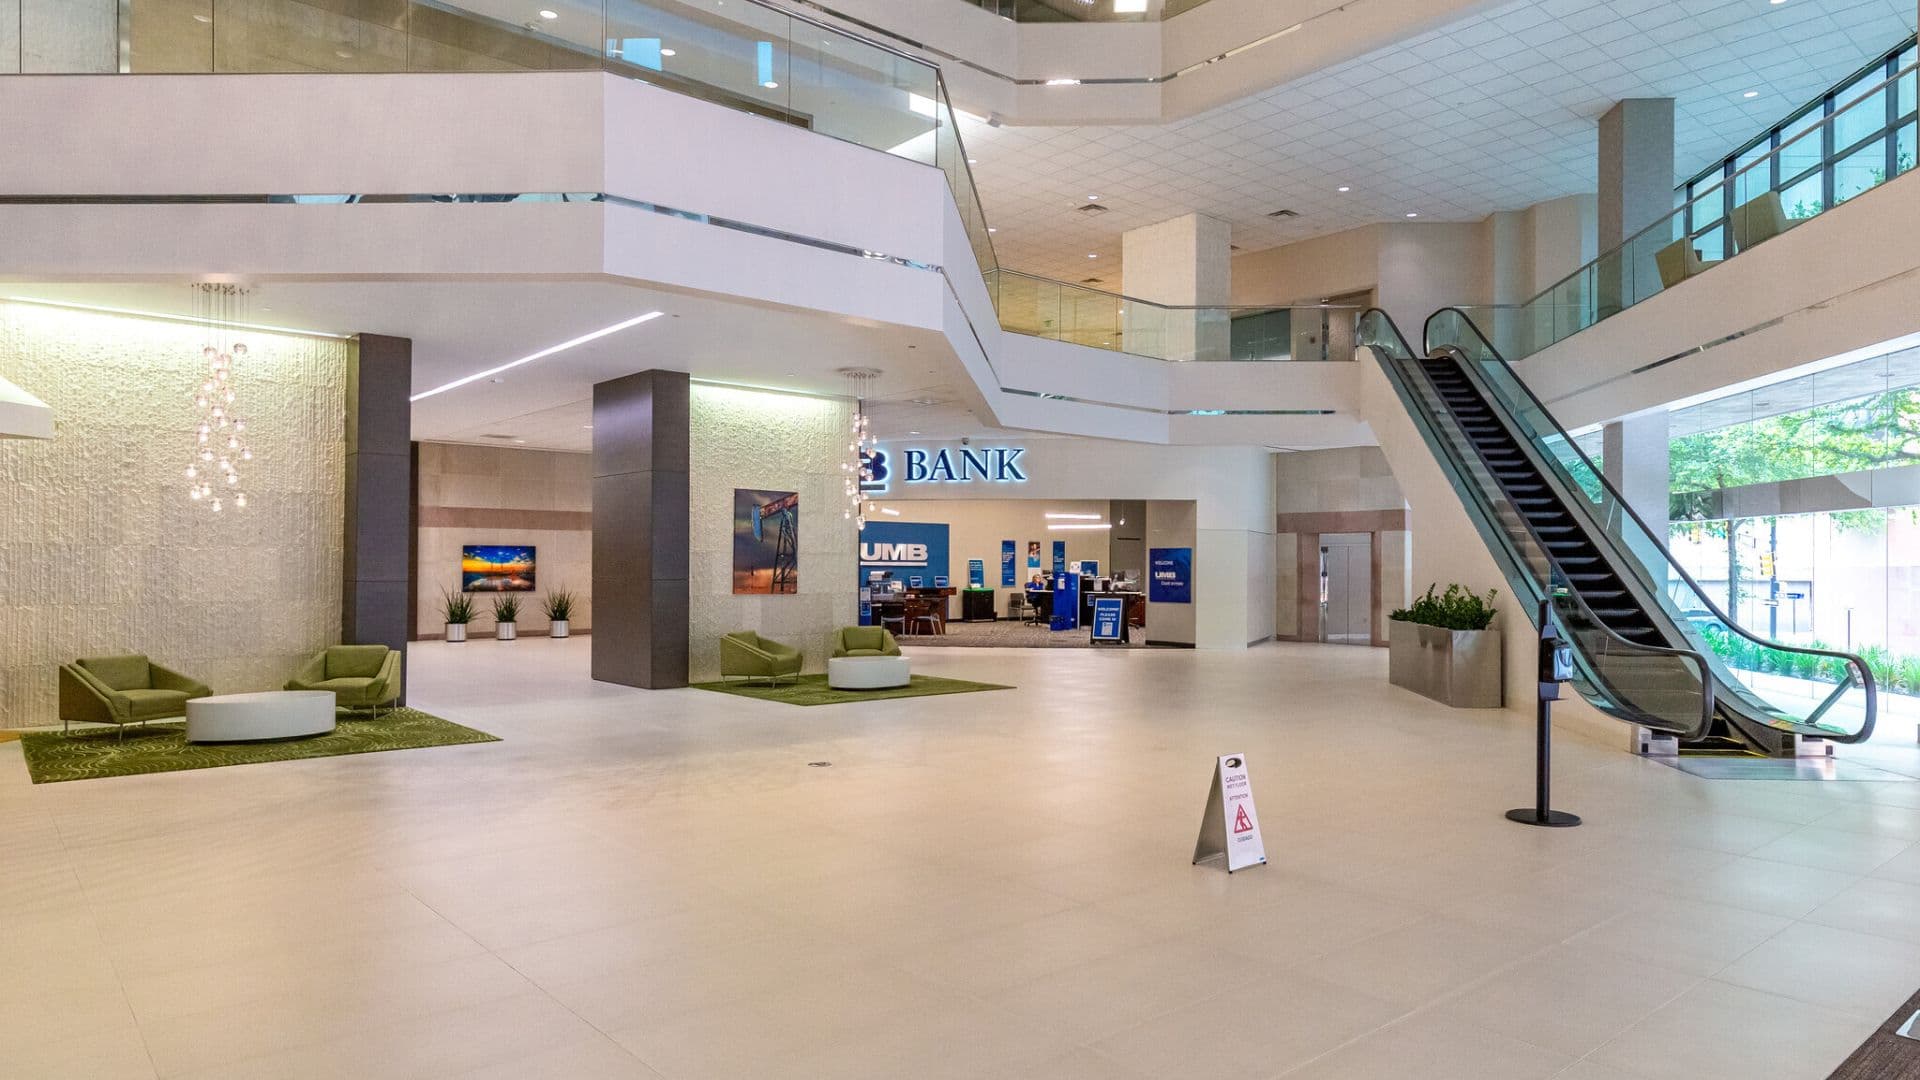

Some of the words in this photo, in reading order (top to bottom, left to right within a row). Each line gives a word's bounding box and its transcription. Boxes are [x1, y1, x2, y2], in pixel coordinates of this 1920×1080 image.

[904, 449, 1026, 481] BANK
[860, 543, 928, 561] UMB
[1225, 774, 1246, 783] CAUTION
